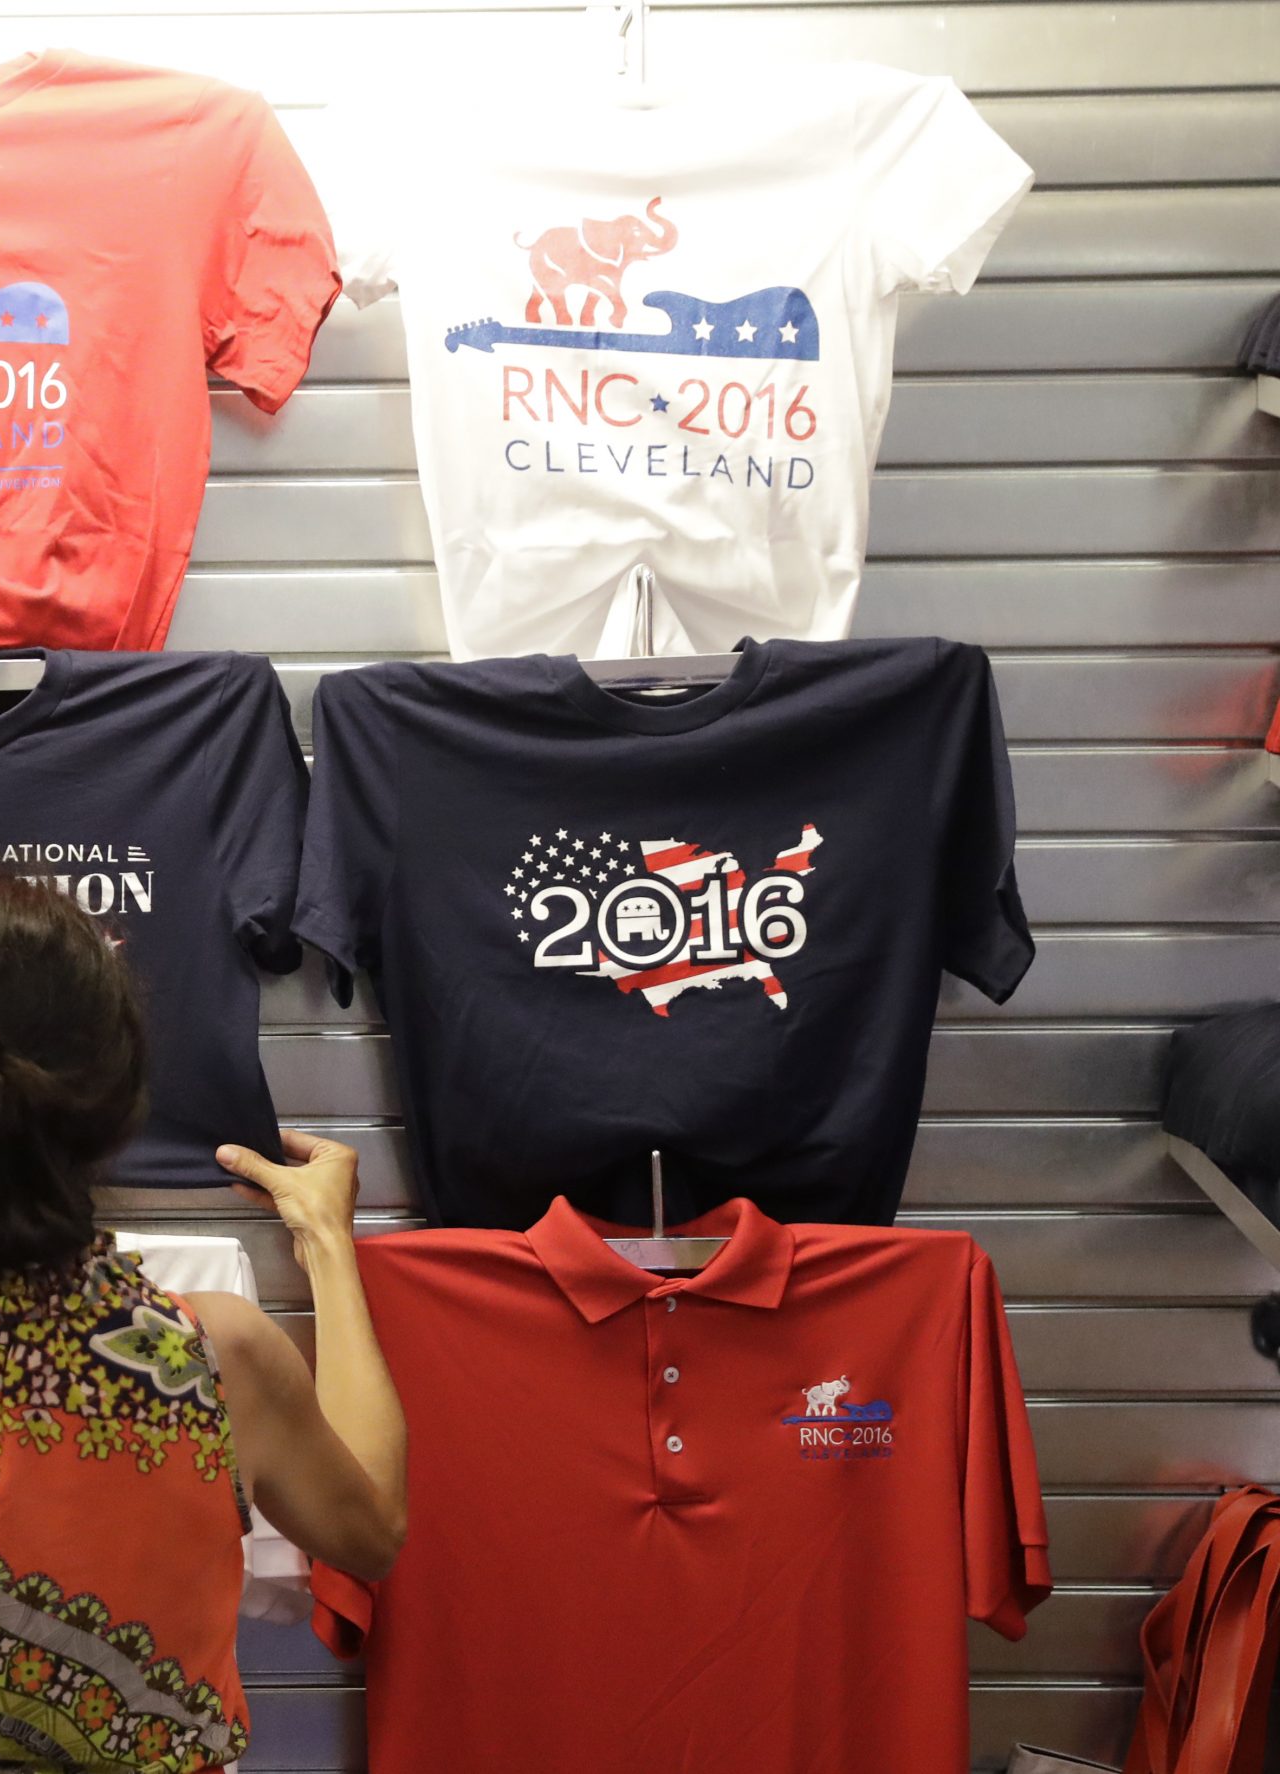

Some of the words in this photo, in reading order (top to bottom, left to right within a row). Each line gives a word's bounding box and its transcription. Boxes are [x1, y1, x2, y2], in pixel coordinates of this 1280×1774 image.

[503, 365, 643, 427] RNC
[677, 378, 817, 441] 2016
[505, 439, 814, 489] CLEVELAND
[530, 875, 807, 968] 2016
[800, 1428, 844, 1446] RNC
[852, 1427, 892, 1445] 2016
